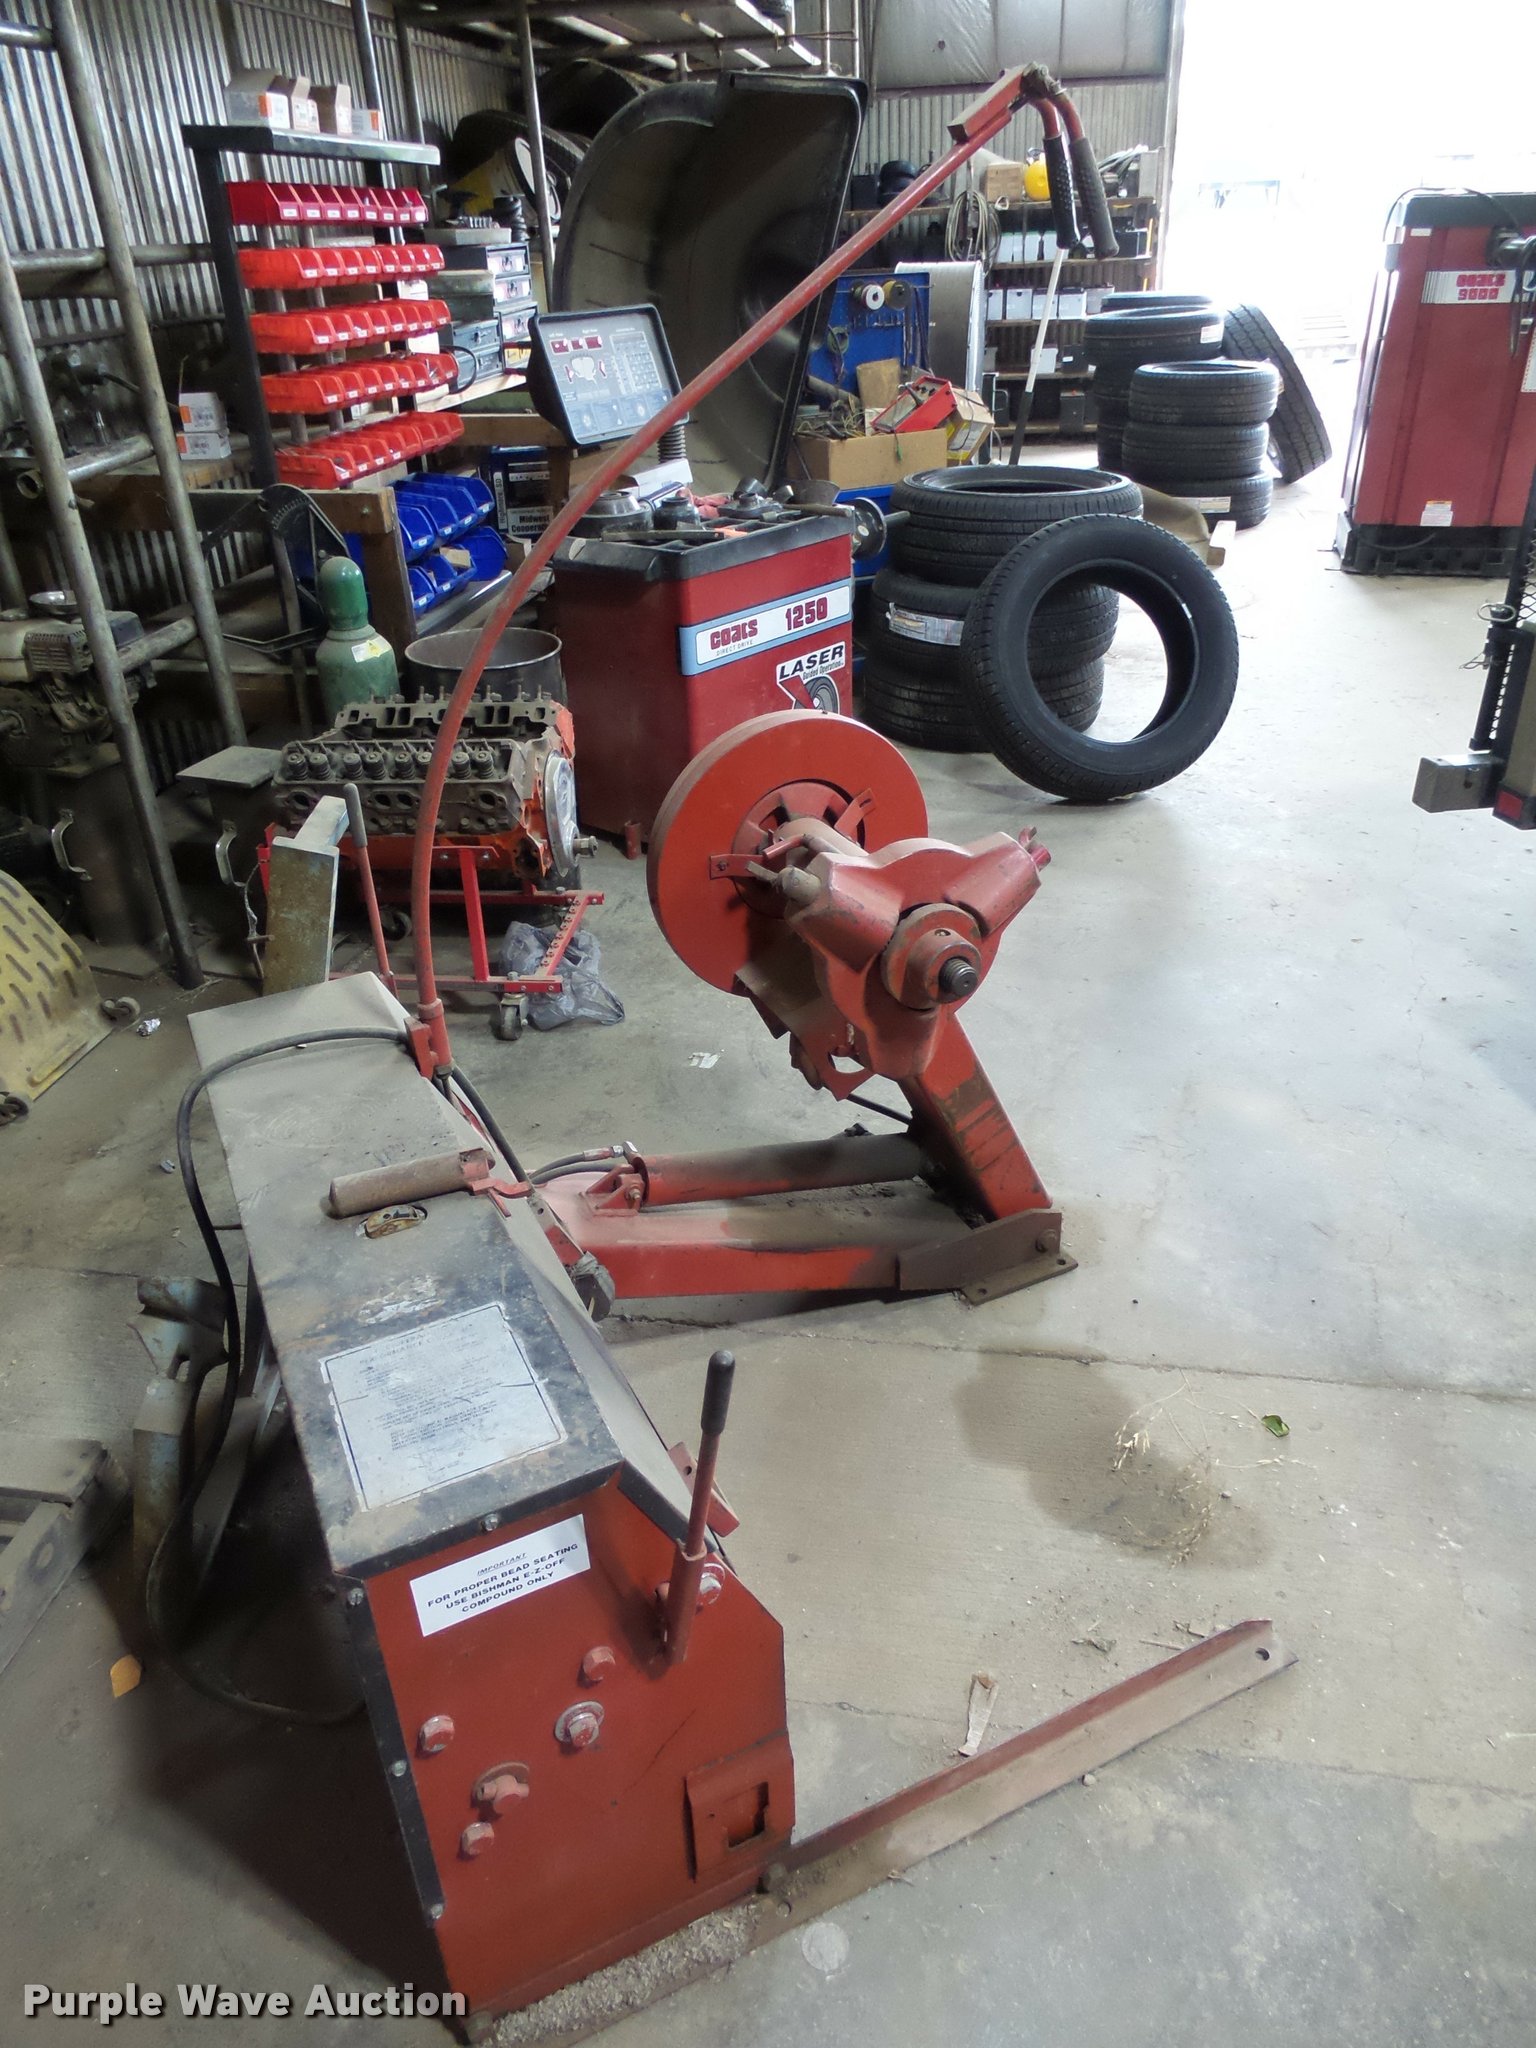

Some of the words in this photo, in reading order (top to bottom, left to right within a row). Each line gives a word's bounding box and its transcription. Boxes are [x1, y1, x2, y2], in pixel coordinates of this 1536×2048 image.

[785, 597, 828, 631] 1250
[716, 645, 737, 656] DIRECT
[737, 639, 754, 650] DRIVE
[779, 644, 844, 680] LASER
[802, 669, 819, 681] Guided
[427, 1594, 451, 1607] FOR
[454, 1575, 498, 1596] PROPER
[501, 1563, 530, 1578] BEAD
[533, 1543, 578, 1565] SEATING
[477, 1553, 527, 1576] IMPORTANT
[446, 1597, 468, 1609] USE
[471, 1576, 520, 1599] BISHMAN
[523, 1557, 565, 1578] E-Z-OFF
[462, 1584, 523, 1612] COMPOUND
[527, 1571, 554, 1586] ONLY
